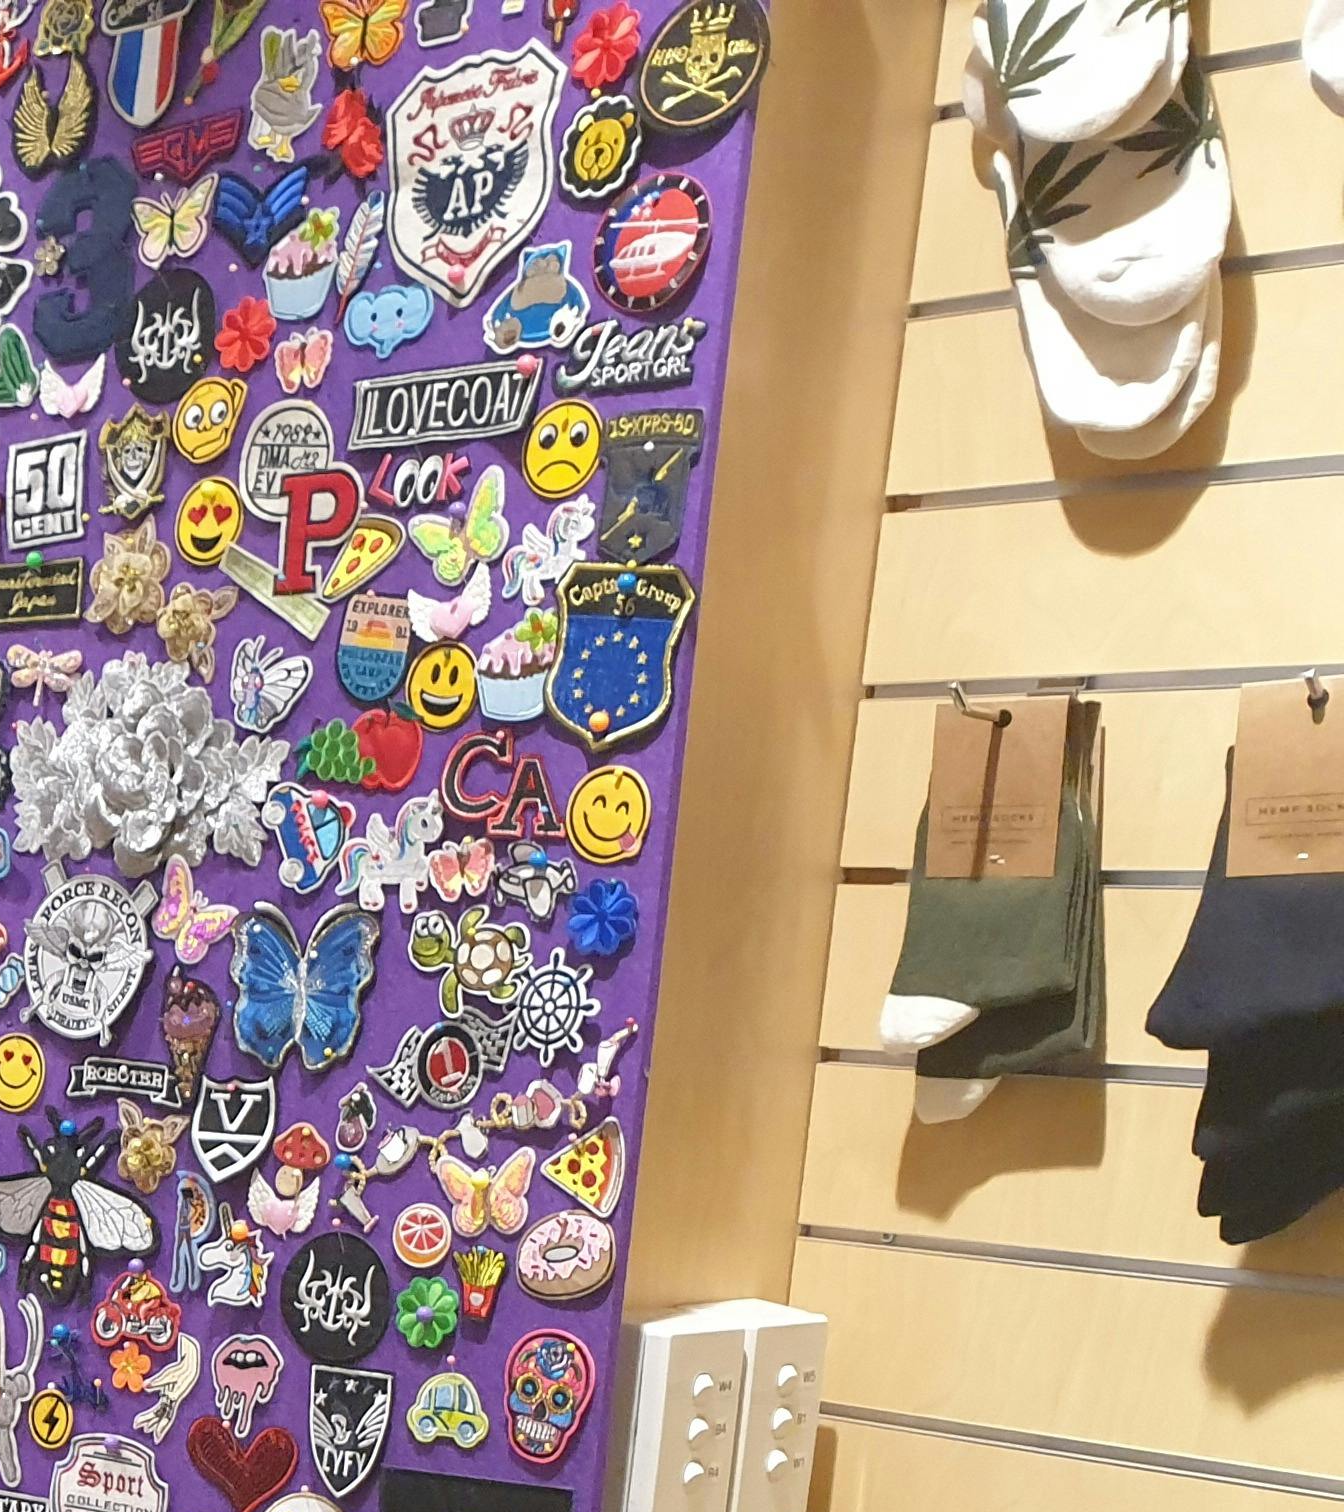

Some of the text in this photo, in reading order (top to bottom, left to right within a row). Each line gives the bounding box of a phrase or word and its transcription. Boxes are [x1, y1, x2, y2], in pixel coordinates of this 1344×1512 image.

[443, 170, 494, 220] AP
[15, 442, 78, 515] 50
[368, 453, 472, 508] LOOK
[14, 509, 76, 540] CENT
[273, 470, 360, 596] P
[442, 734, 564, 838] CA
[40, 881, 143, 944] FORCE RECON
[61, 991, 91, 1010] USMC
[433, 1038, 463, 1086] 1
[77, 1461, 145, 1498] Sport
